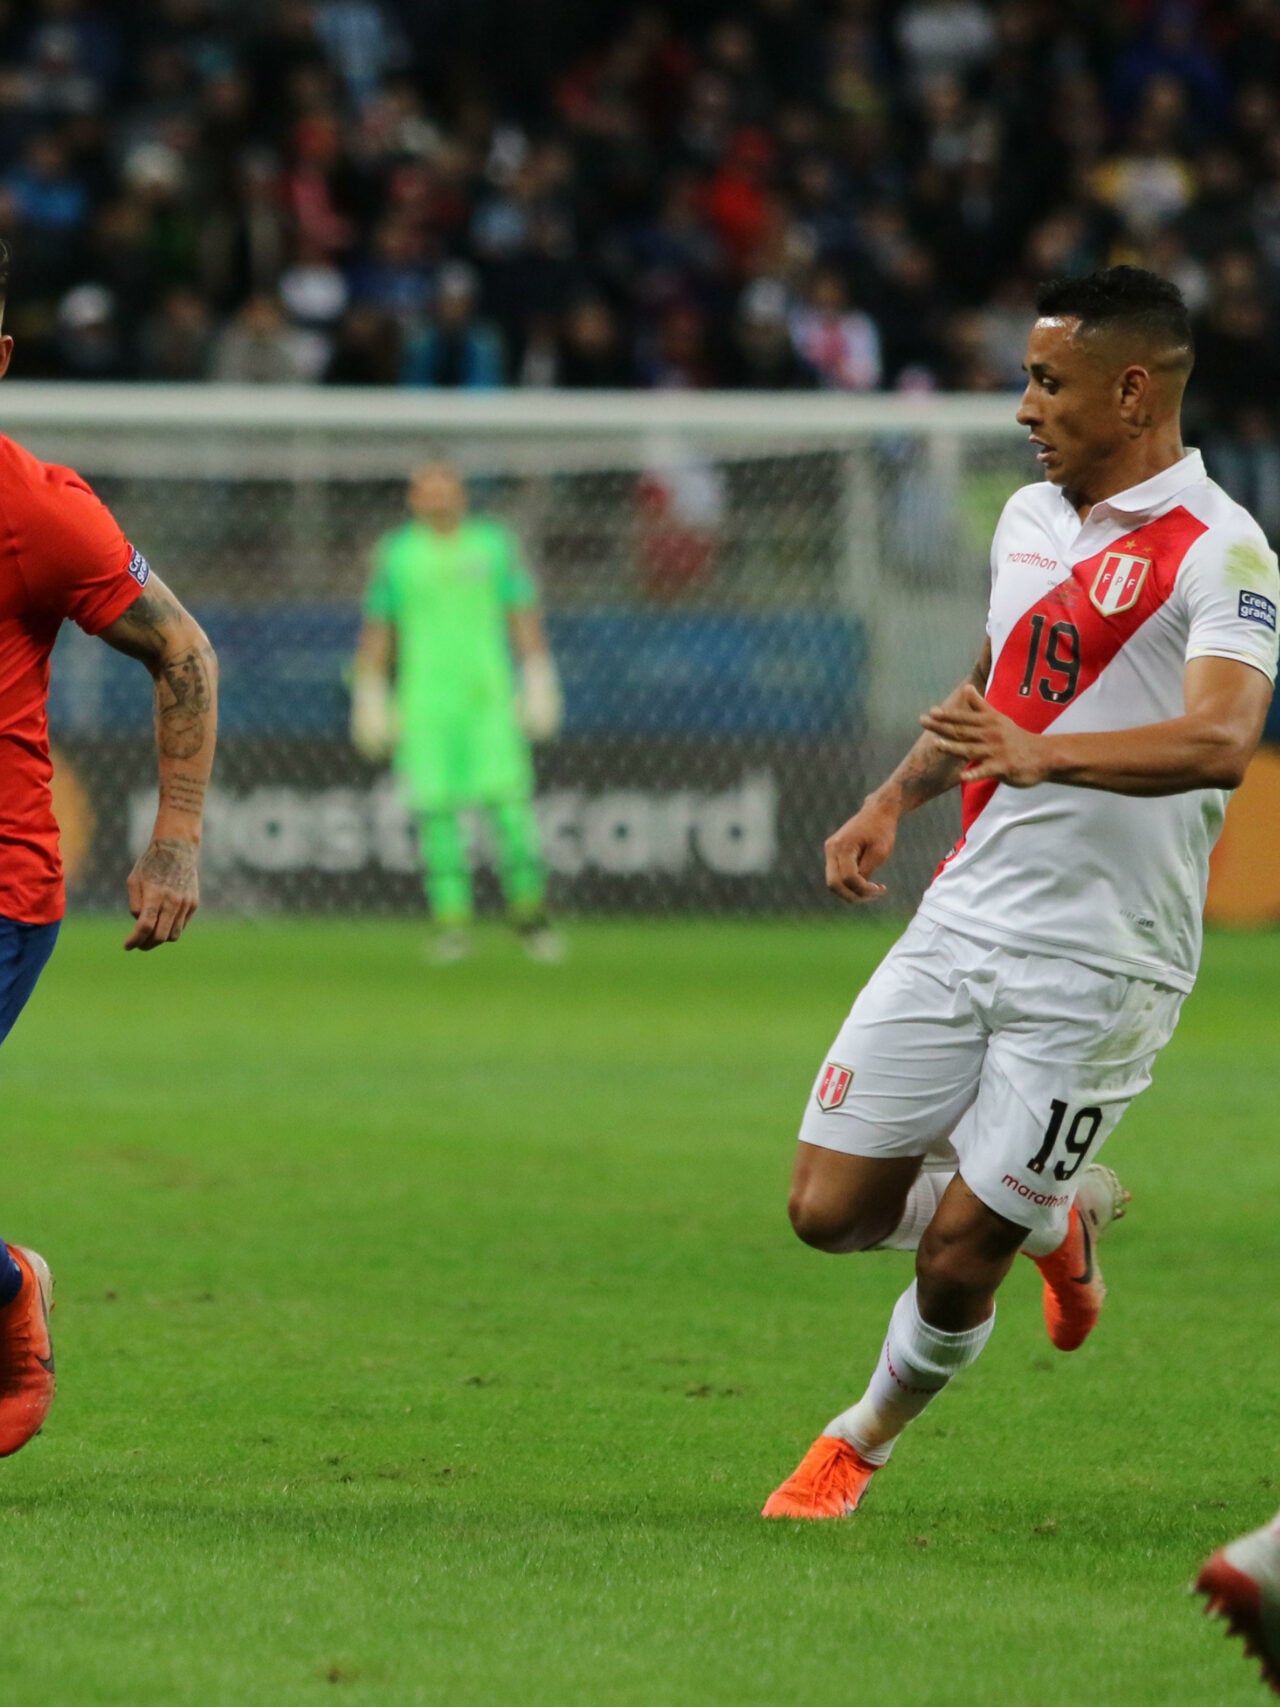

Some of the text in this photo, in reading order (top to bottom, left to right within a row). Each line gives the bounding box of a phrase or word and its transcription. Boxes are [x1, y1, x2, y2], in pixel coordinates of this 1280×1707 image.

[1241, 593, 1268, 610] Cree
[1018, 613, 1081, 704] 19
[129, 766, 777, 876] astcard
[1026, 1098, 1103, 1181] 19
[1001, 1174, 1069, 1208] marathon
